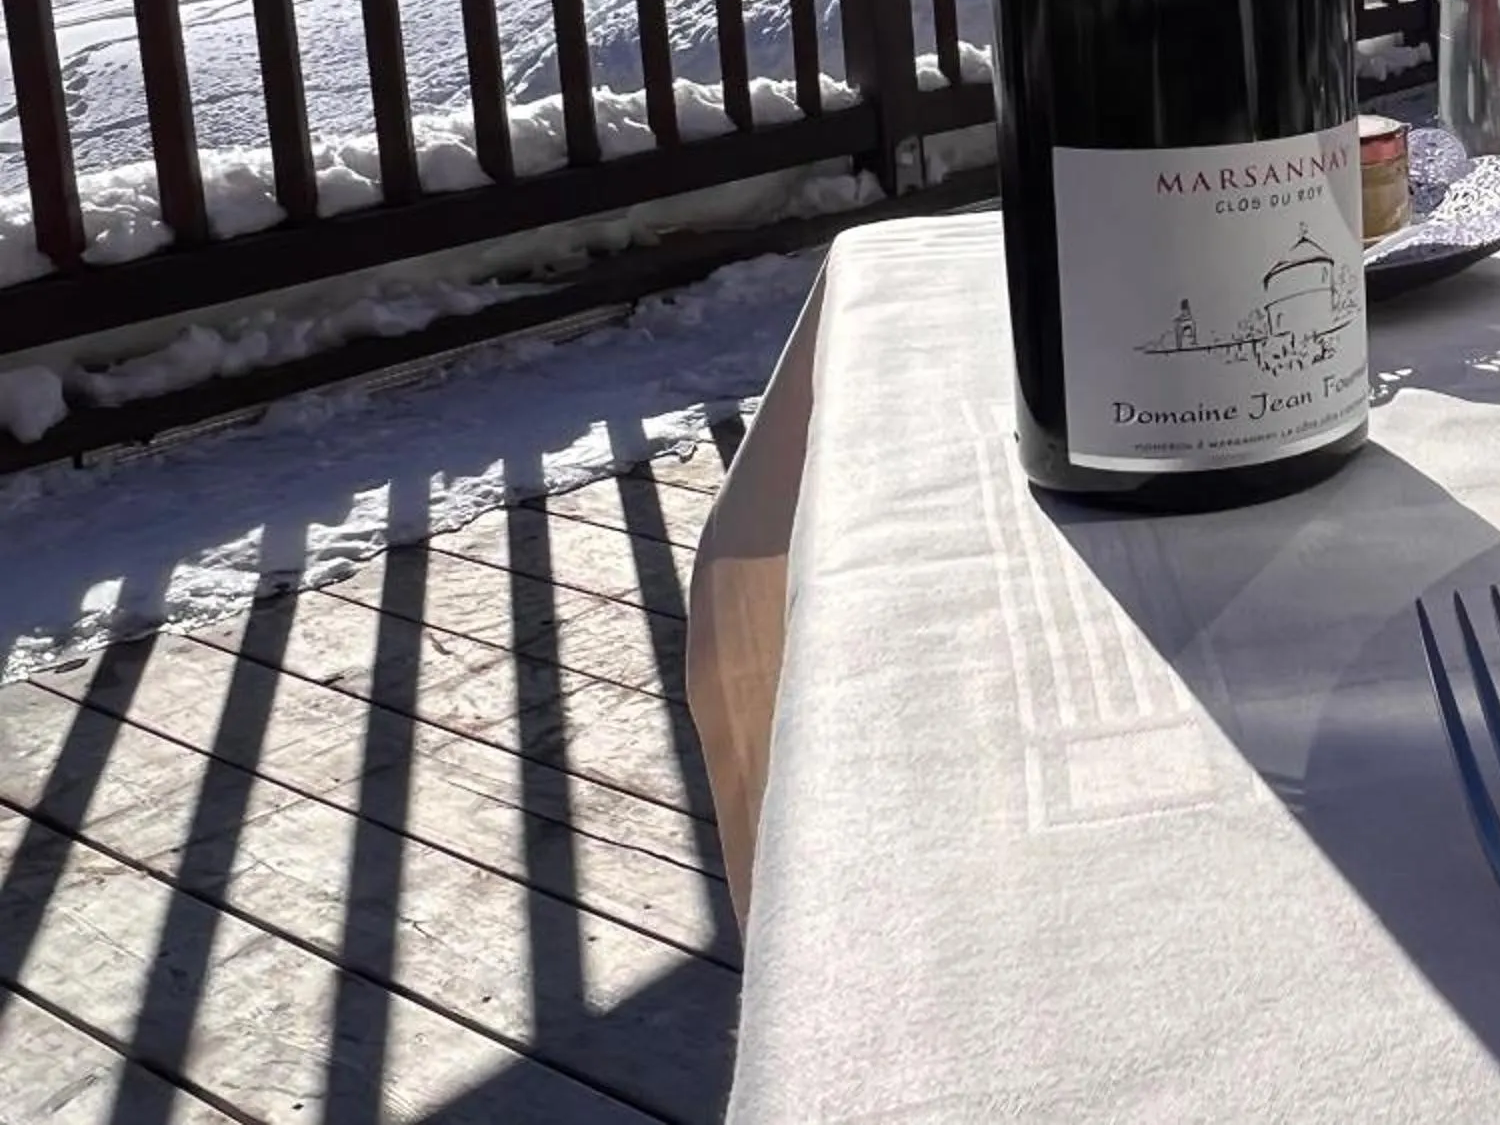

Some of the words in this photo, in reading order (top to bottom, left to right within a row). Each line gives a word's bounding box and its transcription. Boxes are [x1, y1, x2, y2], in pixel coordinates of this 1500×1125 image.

[1269, 191, 1291, 208] DU
[1112, 402, 1238, 426] Domaine
[1248, 391, 1313, 421] Jean
